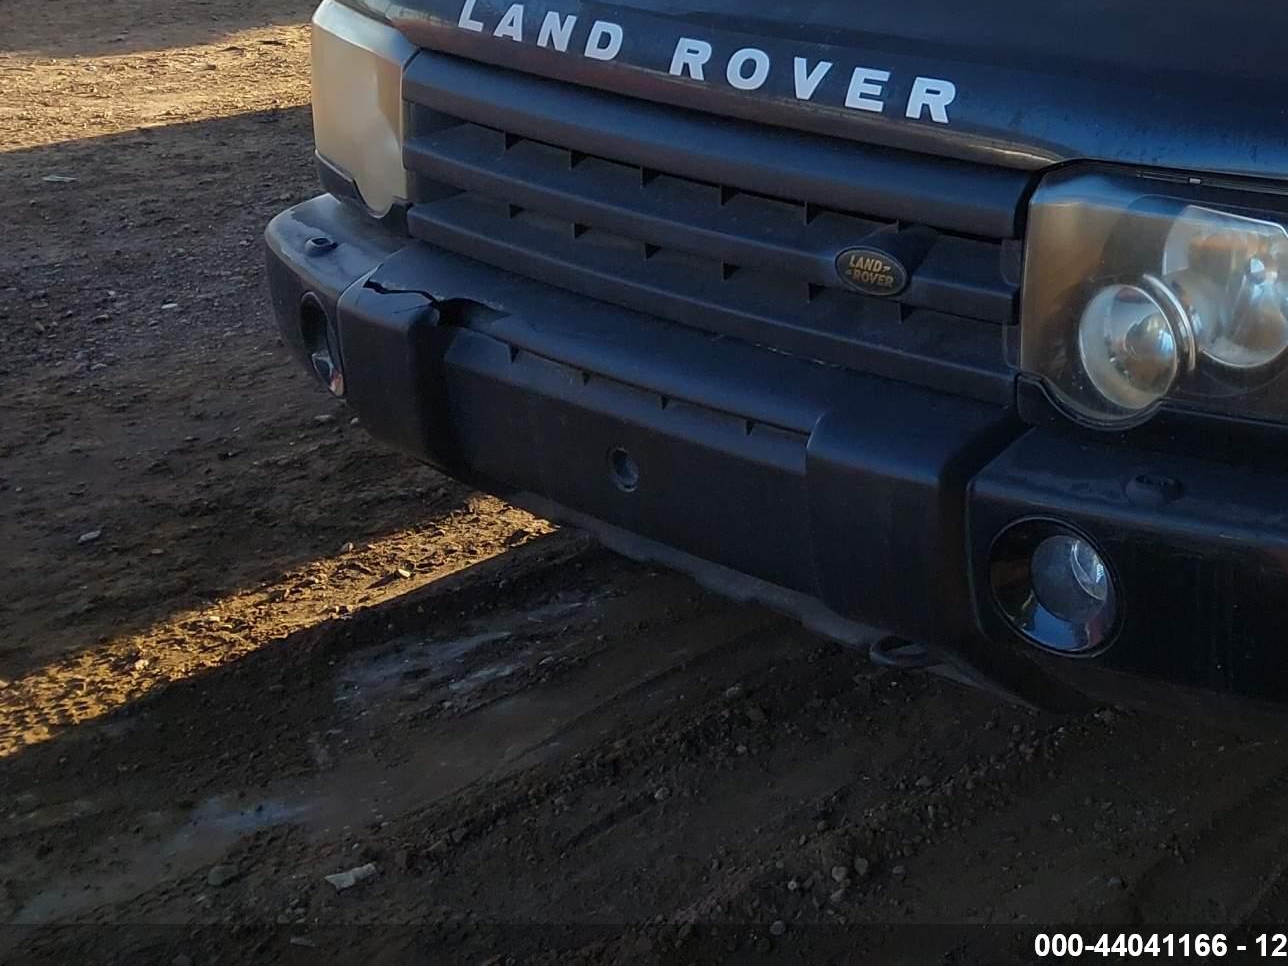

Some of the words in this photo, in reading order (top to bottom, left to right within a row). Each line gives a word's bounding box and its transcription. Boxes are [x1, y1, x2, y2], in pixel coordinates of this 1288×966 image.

[669, 37, 956, 124] ROVER
[849, 255, 883, 272] LAND
[852, 269, 894, 288] ROVER
